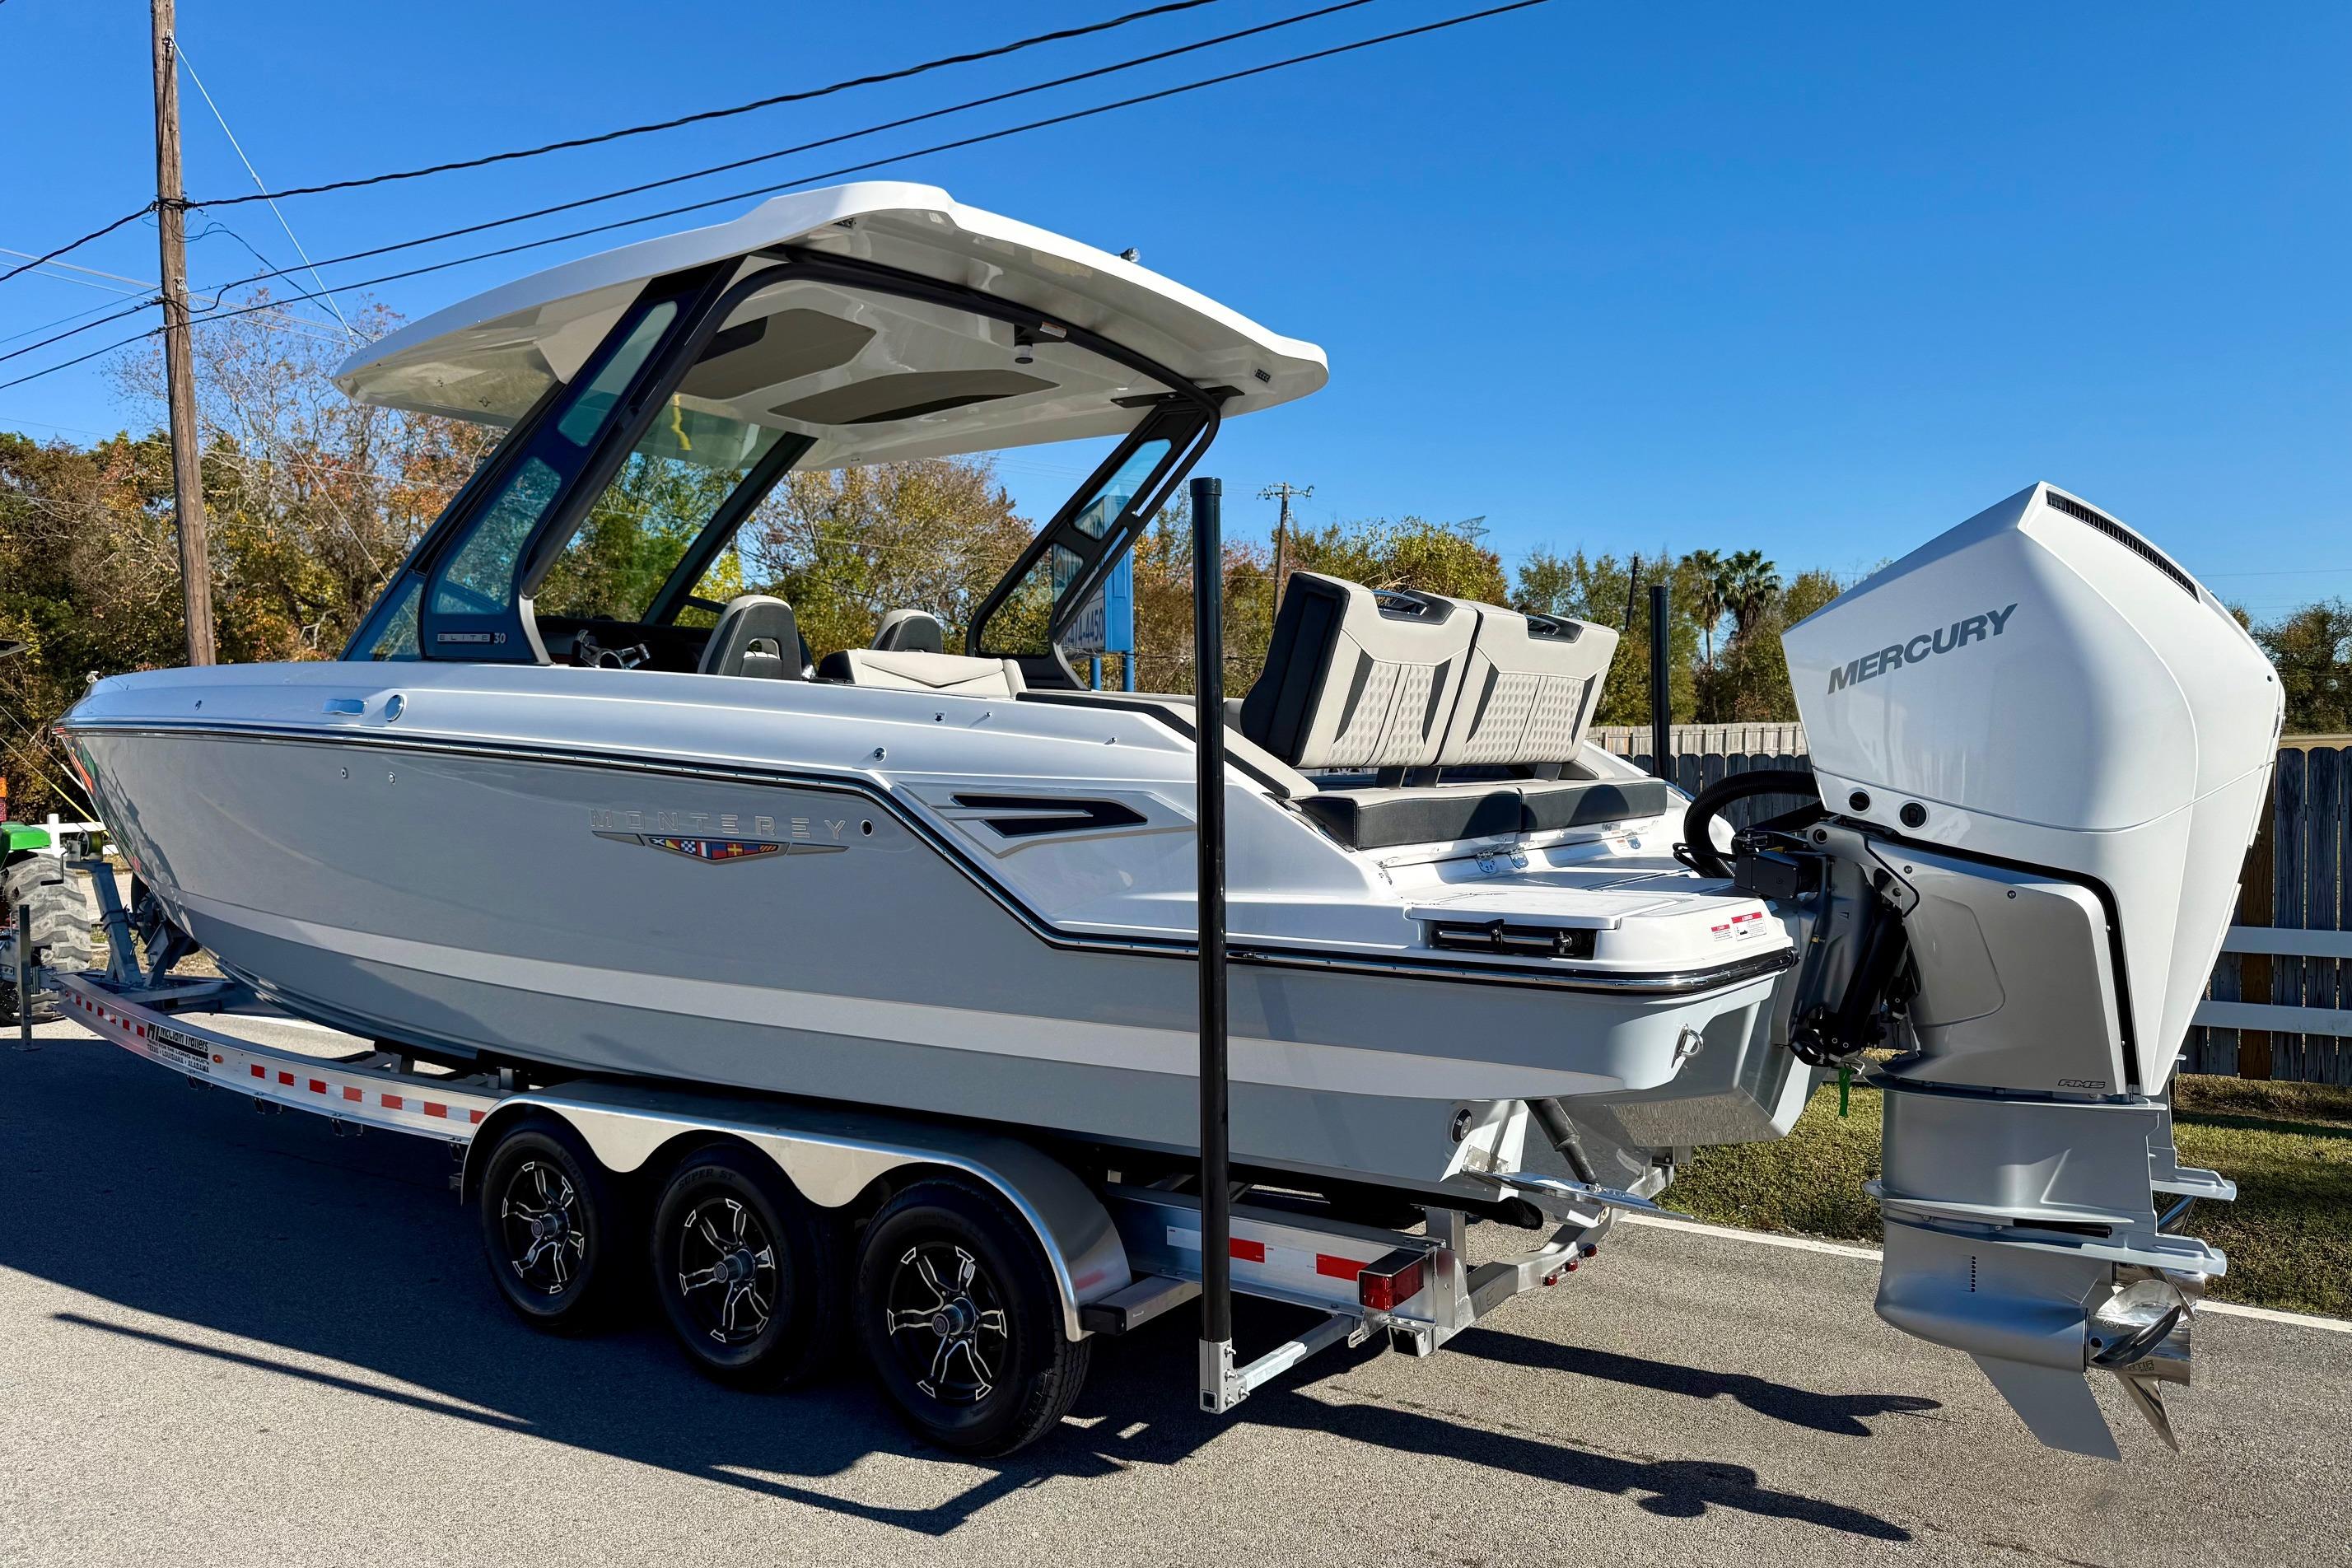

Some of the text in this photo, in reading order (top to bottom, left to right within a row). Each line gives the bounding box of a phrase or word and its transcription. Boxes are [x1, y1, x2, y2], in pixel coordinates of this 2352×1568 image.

[494, 632, 506, 643] 30
[1827, 603, 2018, 695] MERCURY
[589, 808, 847, 840] MONTEREY
[185, 1034, 208, 1052] Trailers
[2058, 1079, 2106, 1090] AMS
